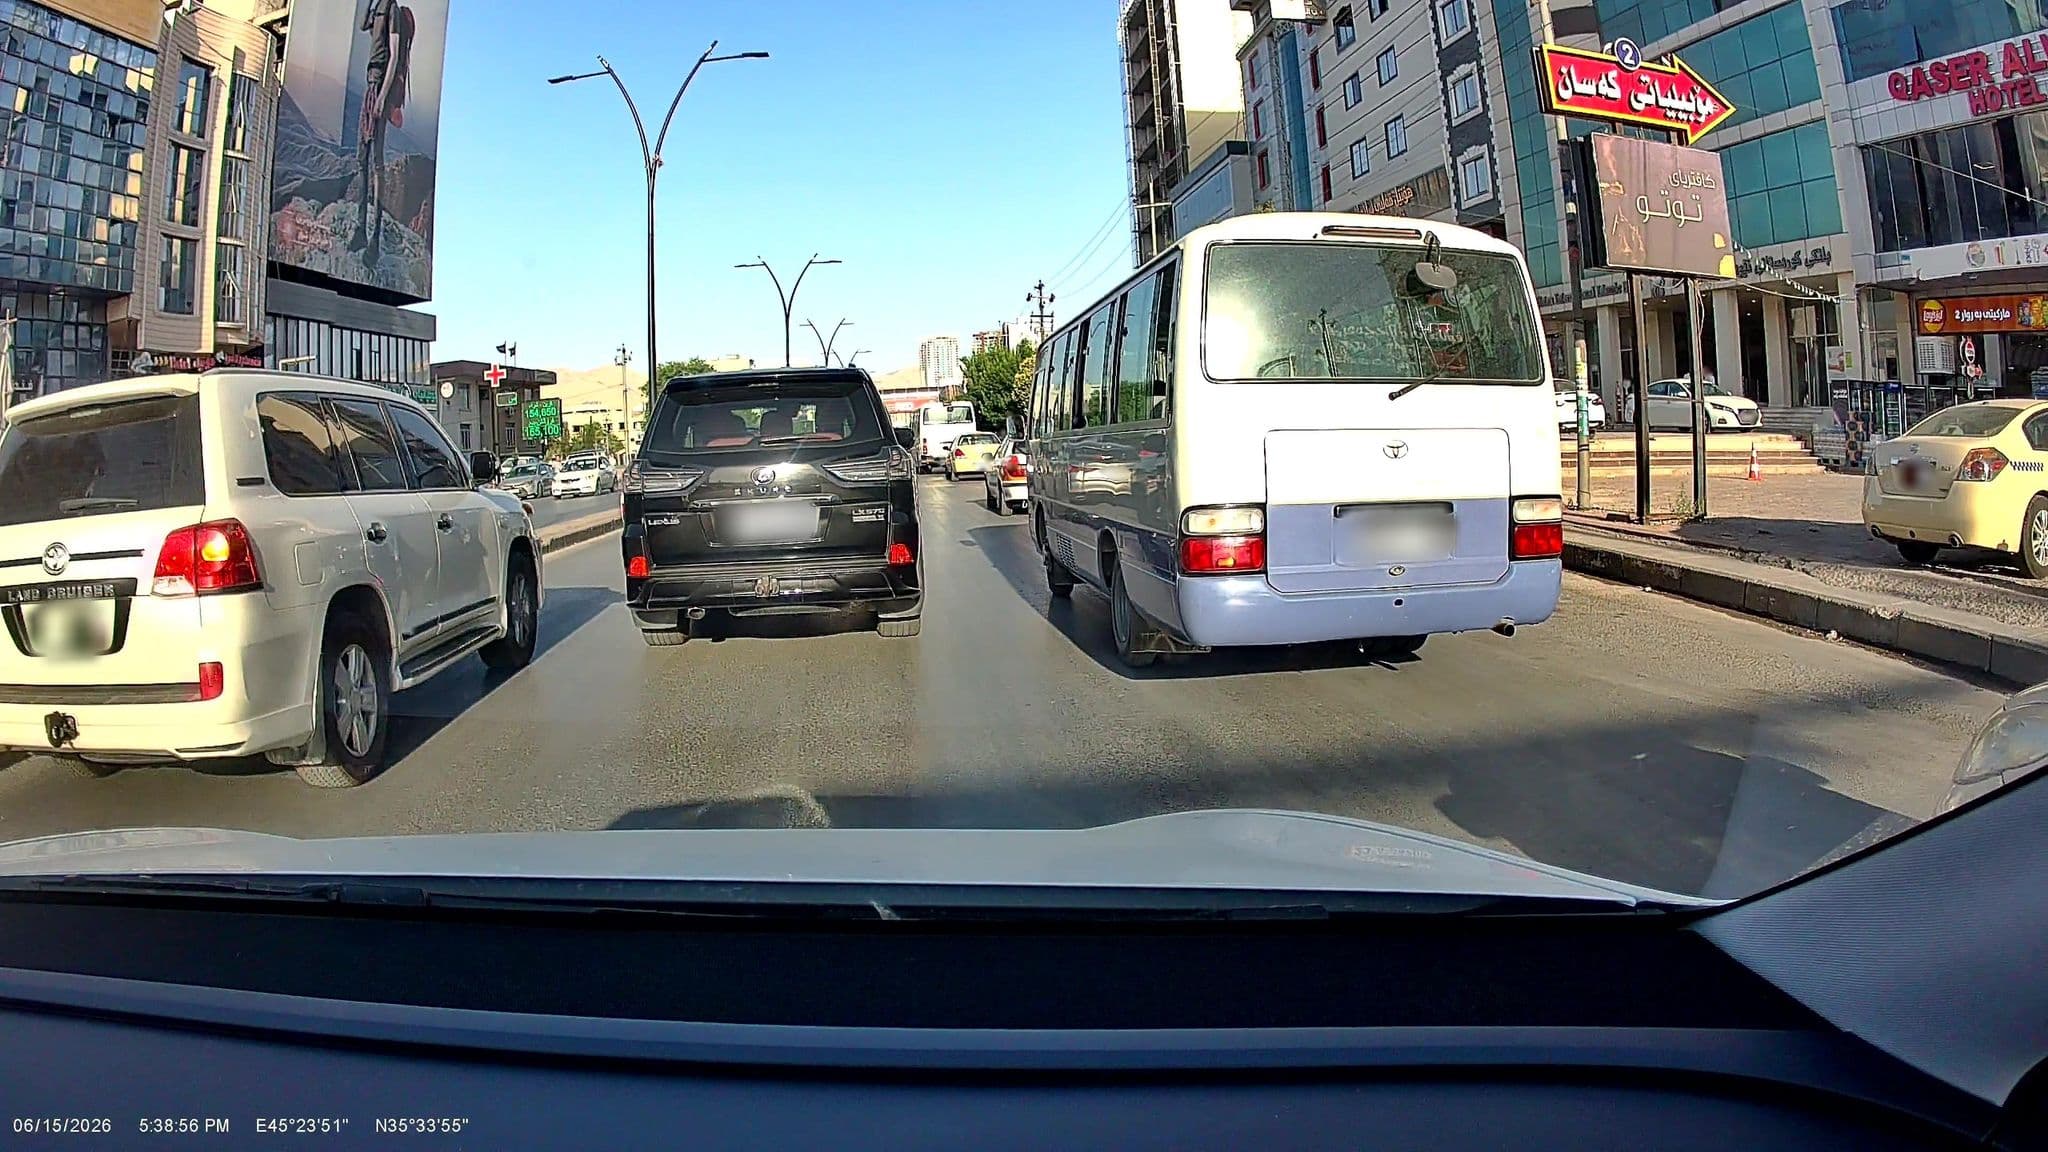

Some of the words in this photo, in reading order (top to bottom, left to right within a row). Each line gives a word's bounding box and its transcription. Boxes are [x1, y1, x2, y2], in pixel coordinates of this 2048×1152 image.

[1623, 43, 1635, 65] 2
[1888, 51, 1995, 101] QASER
[1968, 76, 2047, 117] HOTEL
[8, 589, 40, 602] LAND
